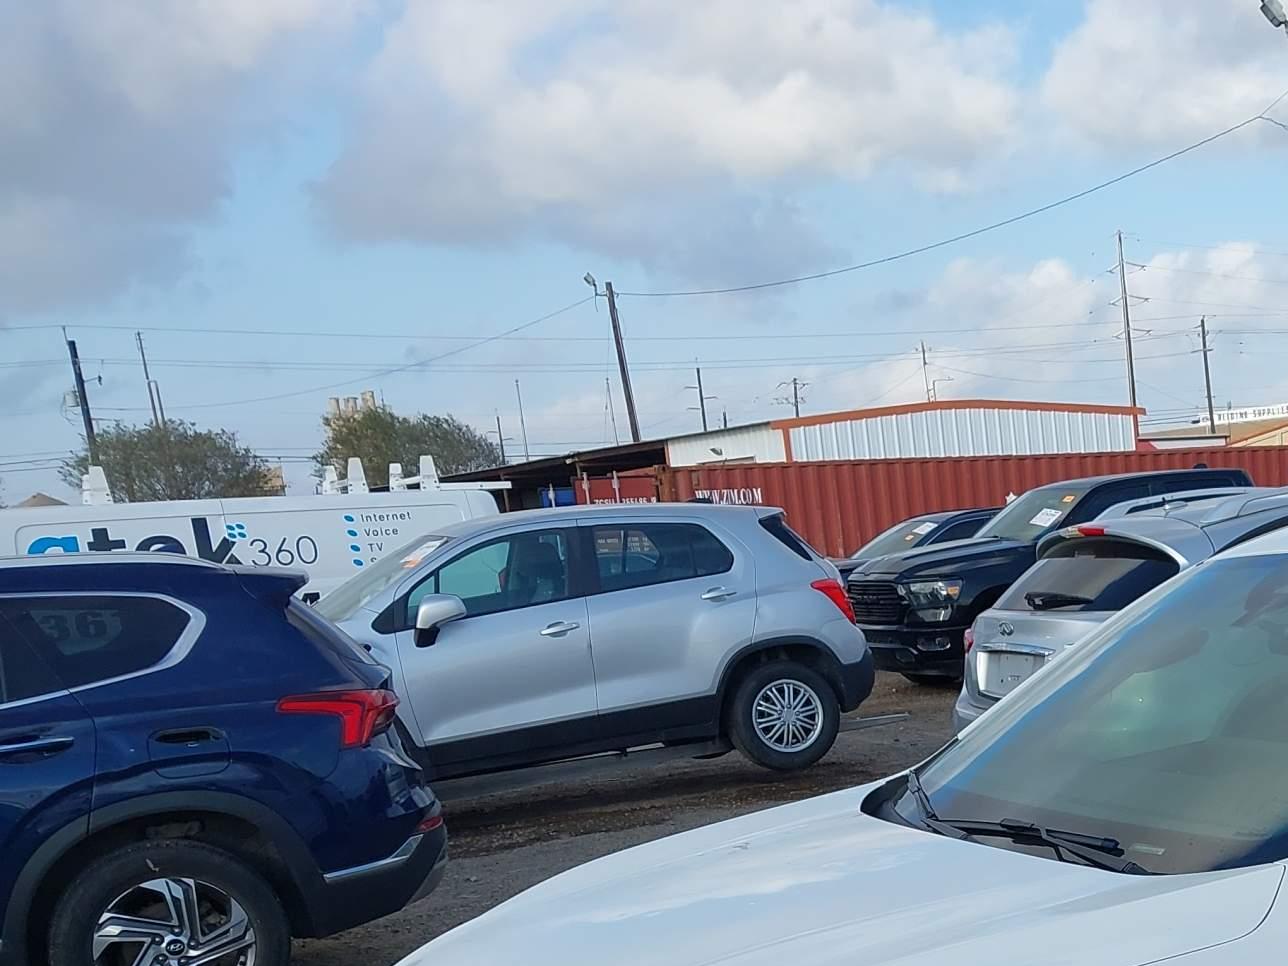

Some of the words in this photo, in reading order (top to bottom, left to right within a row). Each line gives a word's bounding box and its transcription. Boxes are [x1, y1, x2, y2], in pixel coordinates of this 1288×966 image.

[360, 511, 412, 523] Internet
[363, 526, 399, 538] Voice
[368, 542, 384, 553] TV
